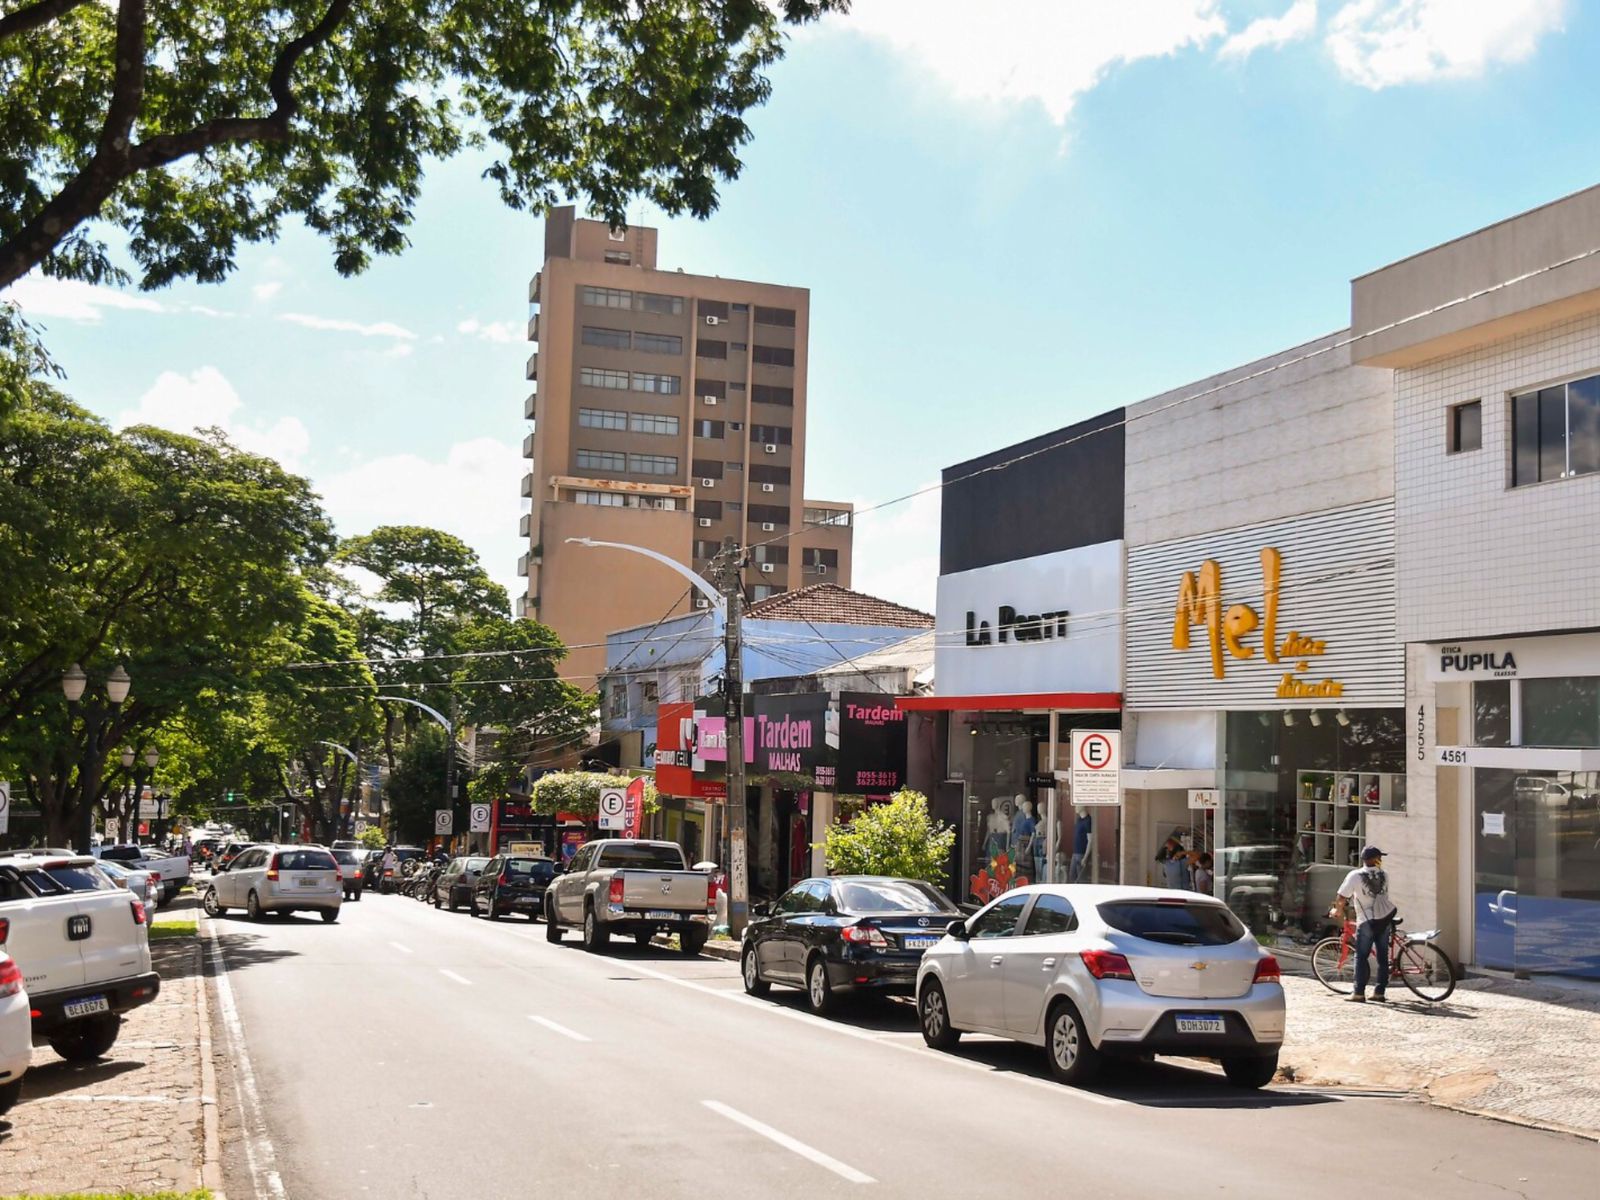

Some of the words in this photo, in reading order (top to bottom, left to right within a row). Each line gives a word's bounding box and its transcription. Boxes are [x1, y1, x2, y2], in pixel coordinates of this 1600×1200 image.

[1172, 547, 1281, 679] Mel
[1441, 652, 1517, 672] PUPILA
[846, 704, 904, 721] Tardem
[758, 713, 812, 749] Tardem
[1417, 704, 1425, 760] 4555
[1089, 742, 1102, 761] E
[1441, 749, 1467, 763] 4561
[768, 752, 801, 772] MALHAS
[608, 797, 616, 810] E
[625, 796, 635, 828] CELL
